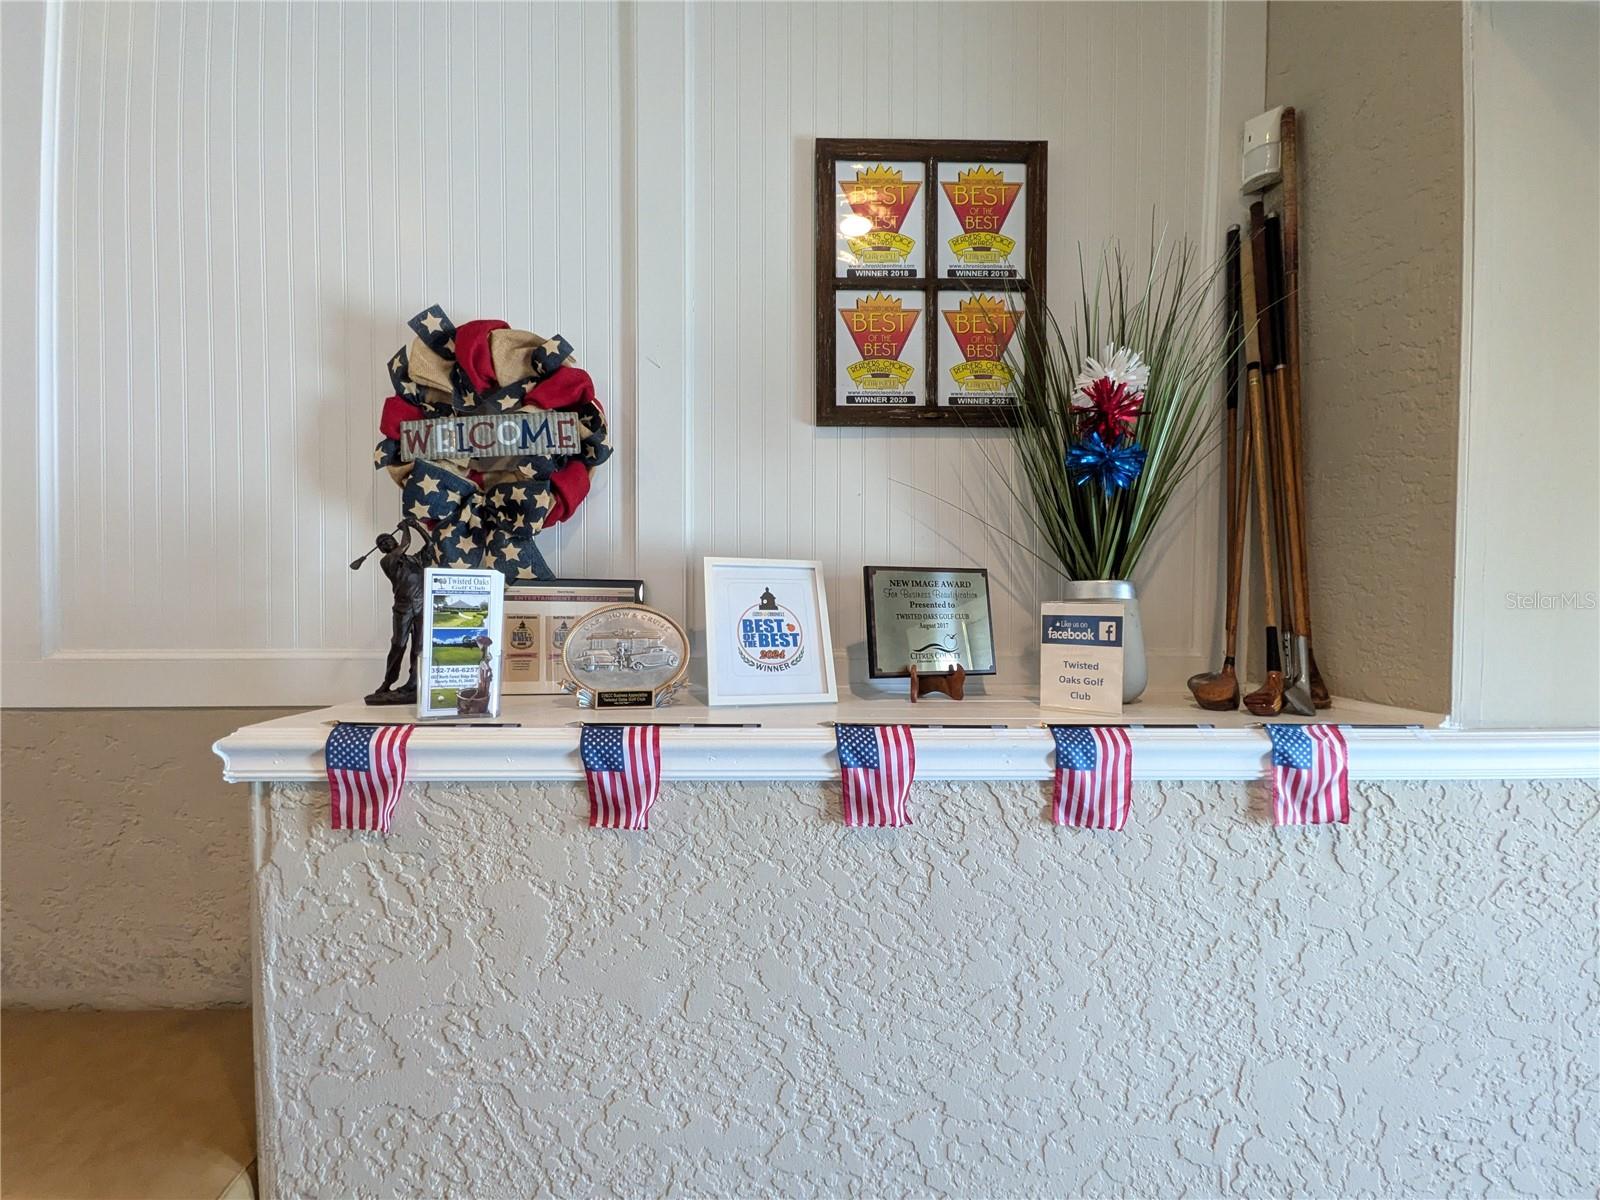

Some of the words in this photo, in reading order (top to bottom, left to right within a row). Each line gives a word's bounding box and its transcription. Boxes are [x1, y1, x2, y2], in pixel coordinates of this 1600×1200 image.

[853, 184, 908, 205] BEST
[953, 185, 1009, 206] BEST
[969, 207, 979, 215] OF
[982, 207, 993, 215] THE
[965, 216, 1000, 229] BEST
[851, 312, 908, 333] BEST
[954, 314, 1010, 335] BEST
[867, 335, 878, 343] OF
[881, 334, 892, 343] THE
[971, 336, 981, 344] OF
[864, 342, 898, 357] BEST
[967, 344, 1001, 358] BEST
[404, 418, 577, 454] WELCOME
[448, 577, 472, 585] Twisted
[473, 578, 489, 586] Oaks
[889, 579, 911, 587] NEW
[912, 580, 940, 588] IMAGE
[941, 580, 971, 588] AWARD
[883, 587, 898, 599] For
[910, 600, 947, 609] Presented
[742, 619, 784, 634] BEST
[919, 622, 937, 630] August
[1060, 620, 1072, 628] Like
[742, 633, 757, 641] OF
[1048, 626, 1095, 641] facebook
[743, 640, 758, 648] THE
[758, 633, 800, 648] BEST
[759, 650, 786, 660] 2024
[910, 652, 934, 660] CITRUS
[755, 662, 791, 673] WINNER
[1063, 660, 1100, 671] Twisted
[1058, 675, 1081, 685] Oaks
[1083, 677, 1104, 687] Golf
[1070, 691, 1091, 701] Club
